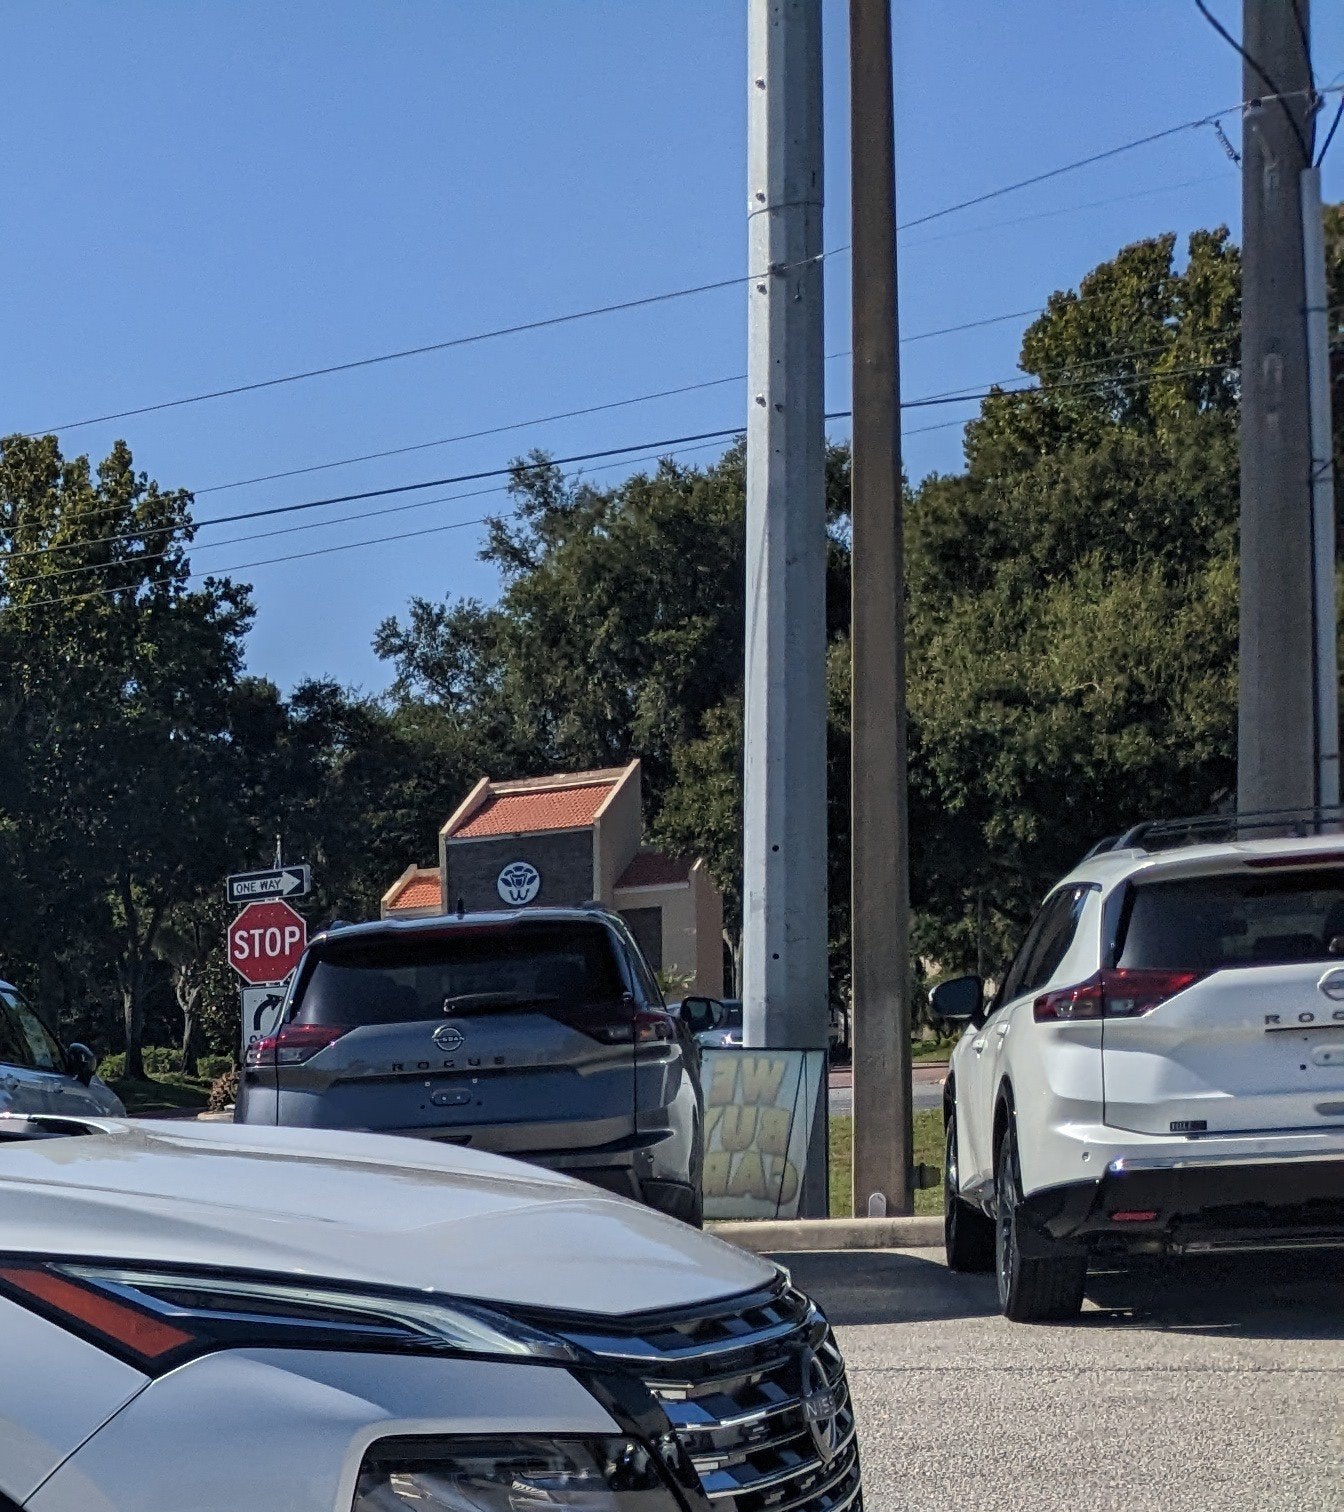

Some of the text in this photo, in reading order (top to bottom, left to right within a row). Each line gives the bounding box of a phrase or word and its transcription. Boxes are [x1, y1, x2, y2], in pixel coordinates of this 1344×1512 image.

[236, 879, 281, 895] ONE WAY
[234, 926, 300, 959] STOP
[392, 1056, 505, 1072] ROGUE
